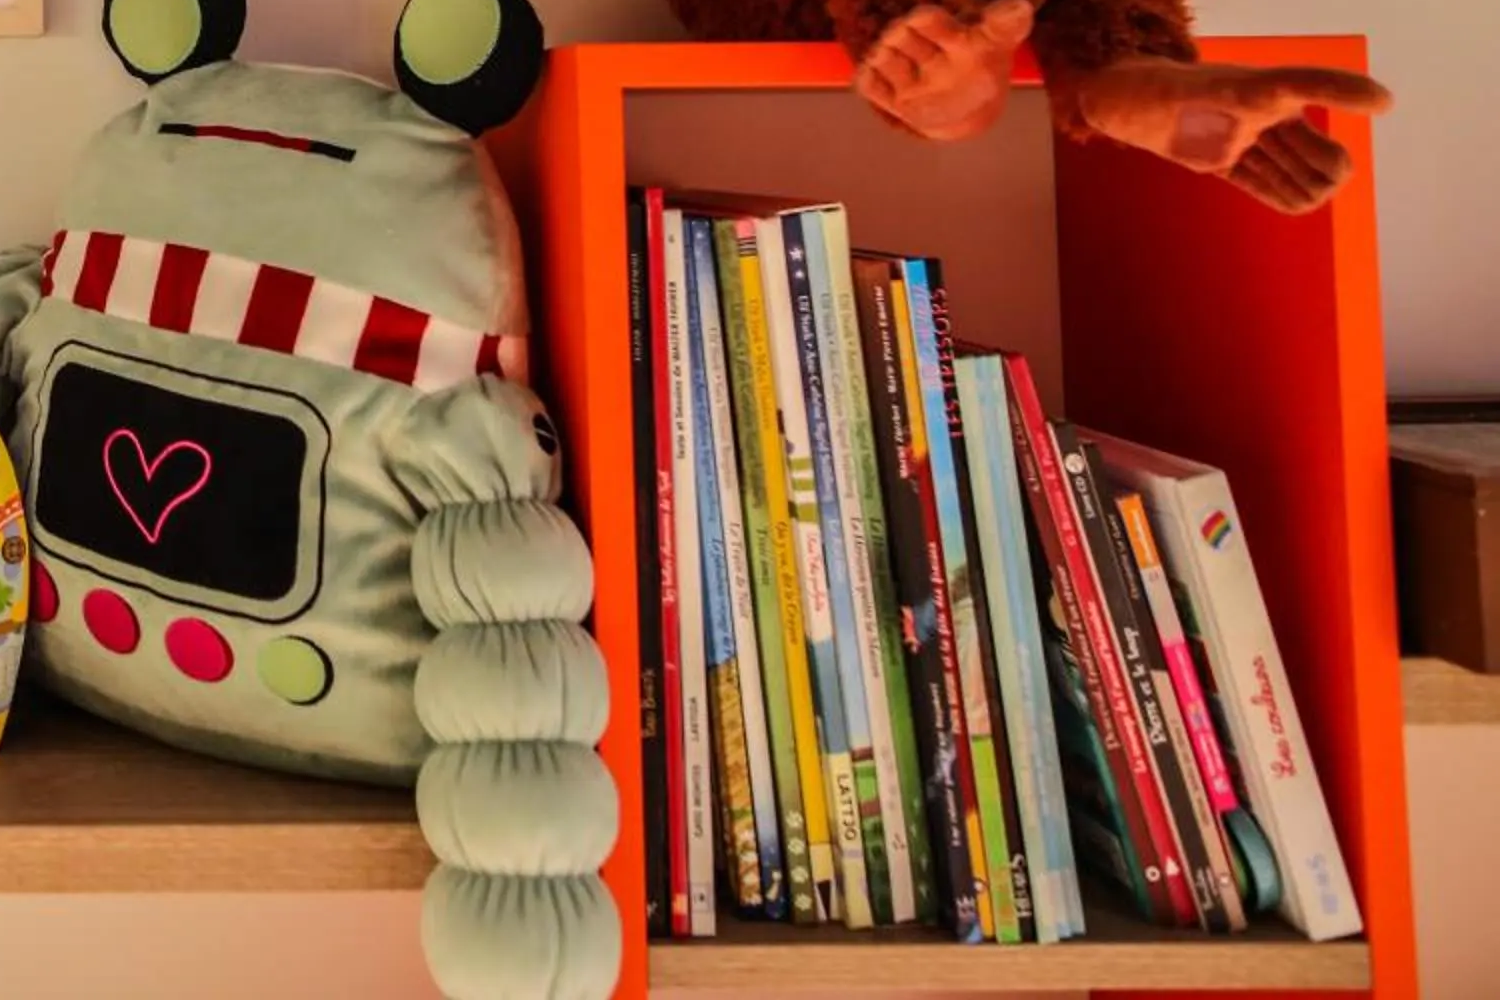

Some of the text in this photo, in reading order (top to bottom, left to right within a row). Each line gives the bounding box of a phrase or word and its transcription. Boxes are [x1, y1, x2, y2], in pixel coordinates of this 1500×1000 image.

[1118, 623, 1145, 660] loup
[1129, 661, 1146, 677] le
[1138, 679, 1152, 696] et
[1139, 698, 1167, 745] Pierre
[1239, 654, 1298, 781] Les couleurs
[835, 773, 857, 842] LATTJO
